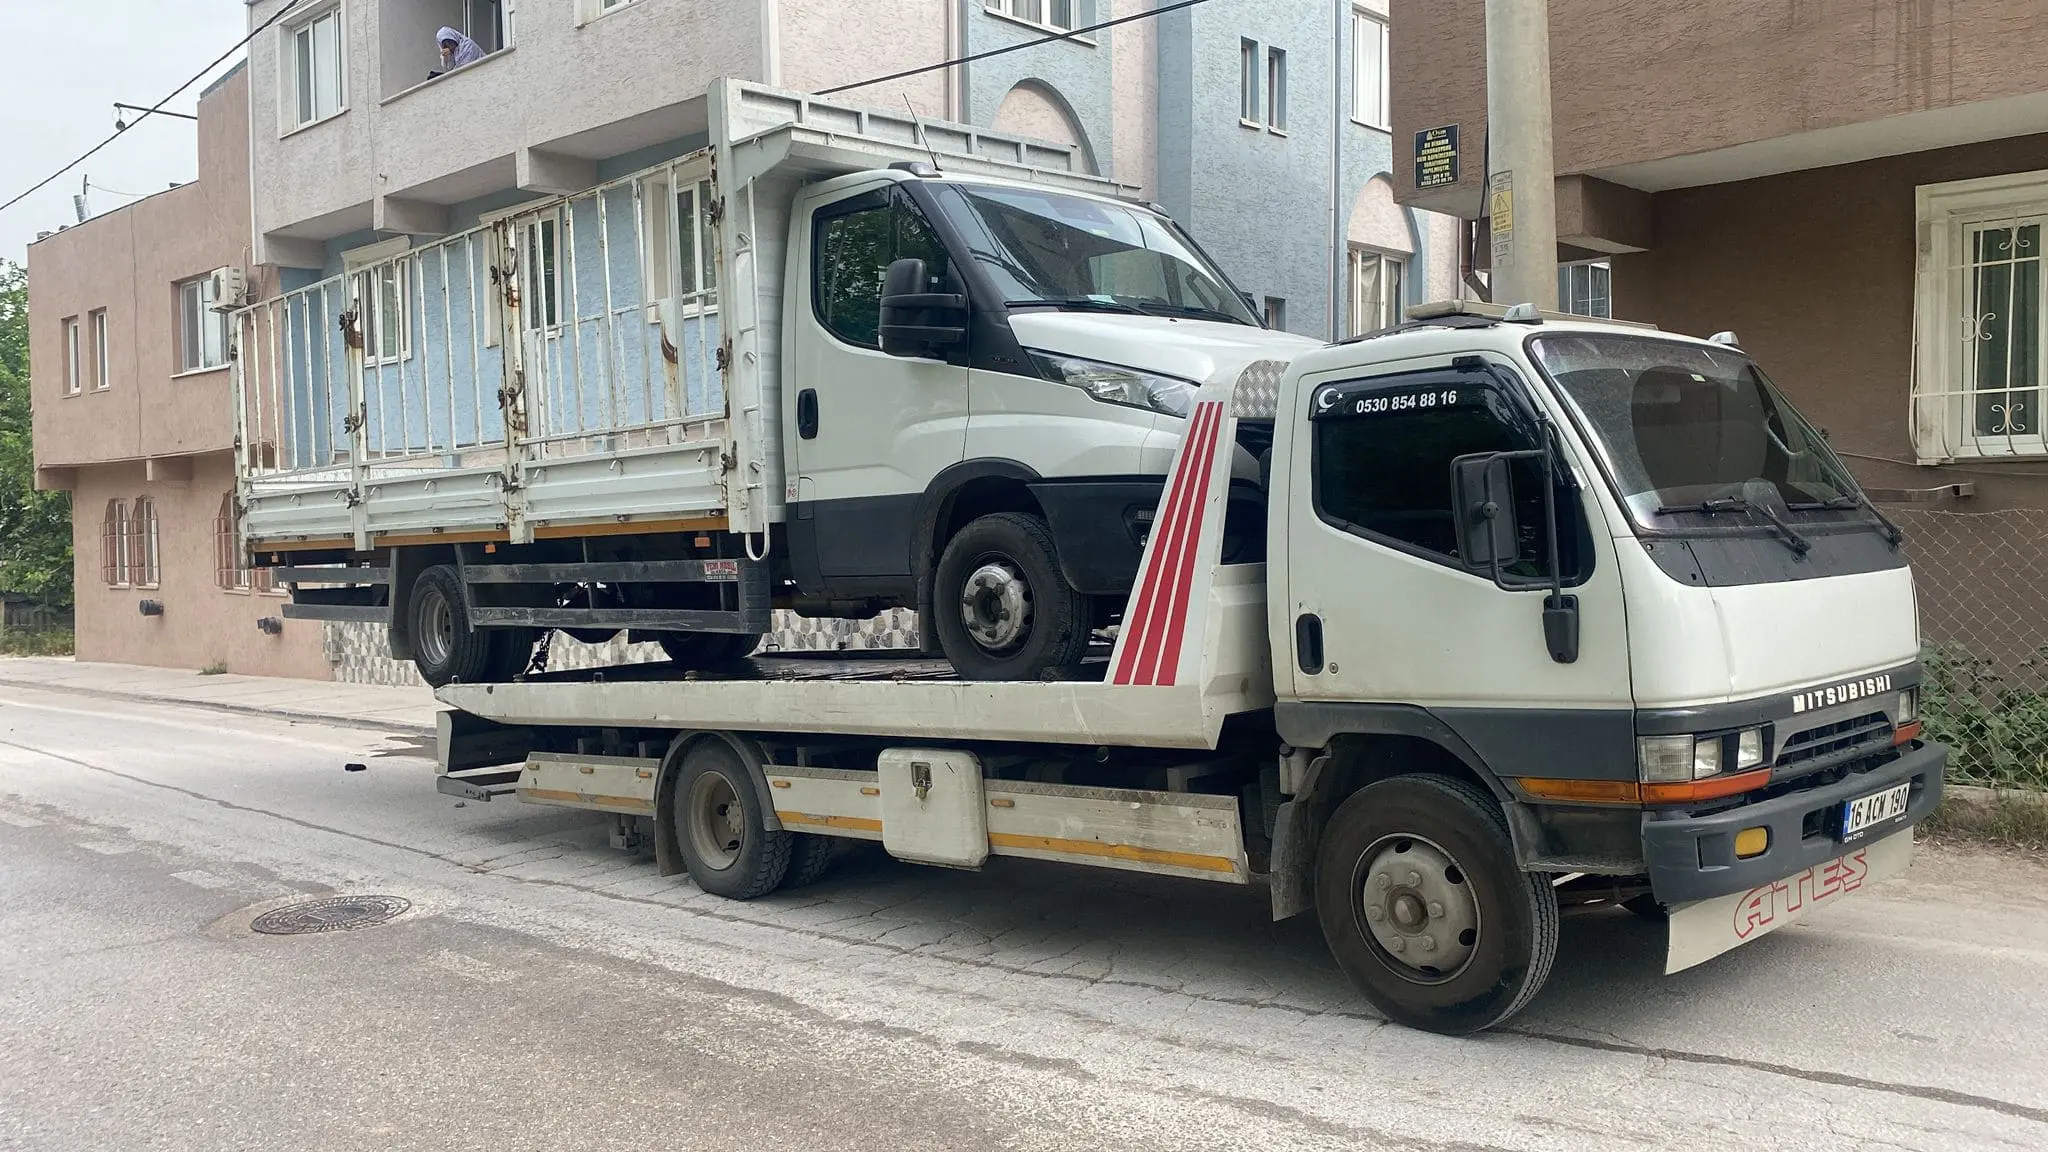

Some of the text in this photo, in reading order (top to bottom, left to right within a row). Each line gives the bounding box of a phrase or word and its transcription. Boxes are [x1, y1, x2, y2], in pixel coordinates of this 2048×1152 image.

[1356, 390, 1457, 414] 0530 854 88 16
[1792, 674, 1891, 713] MITSUBISHI
[1851, 802, 1863, 829] 16
[1890, 786, 1908, 815] 190
